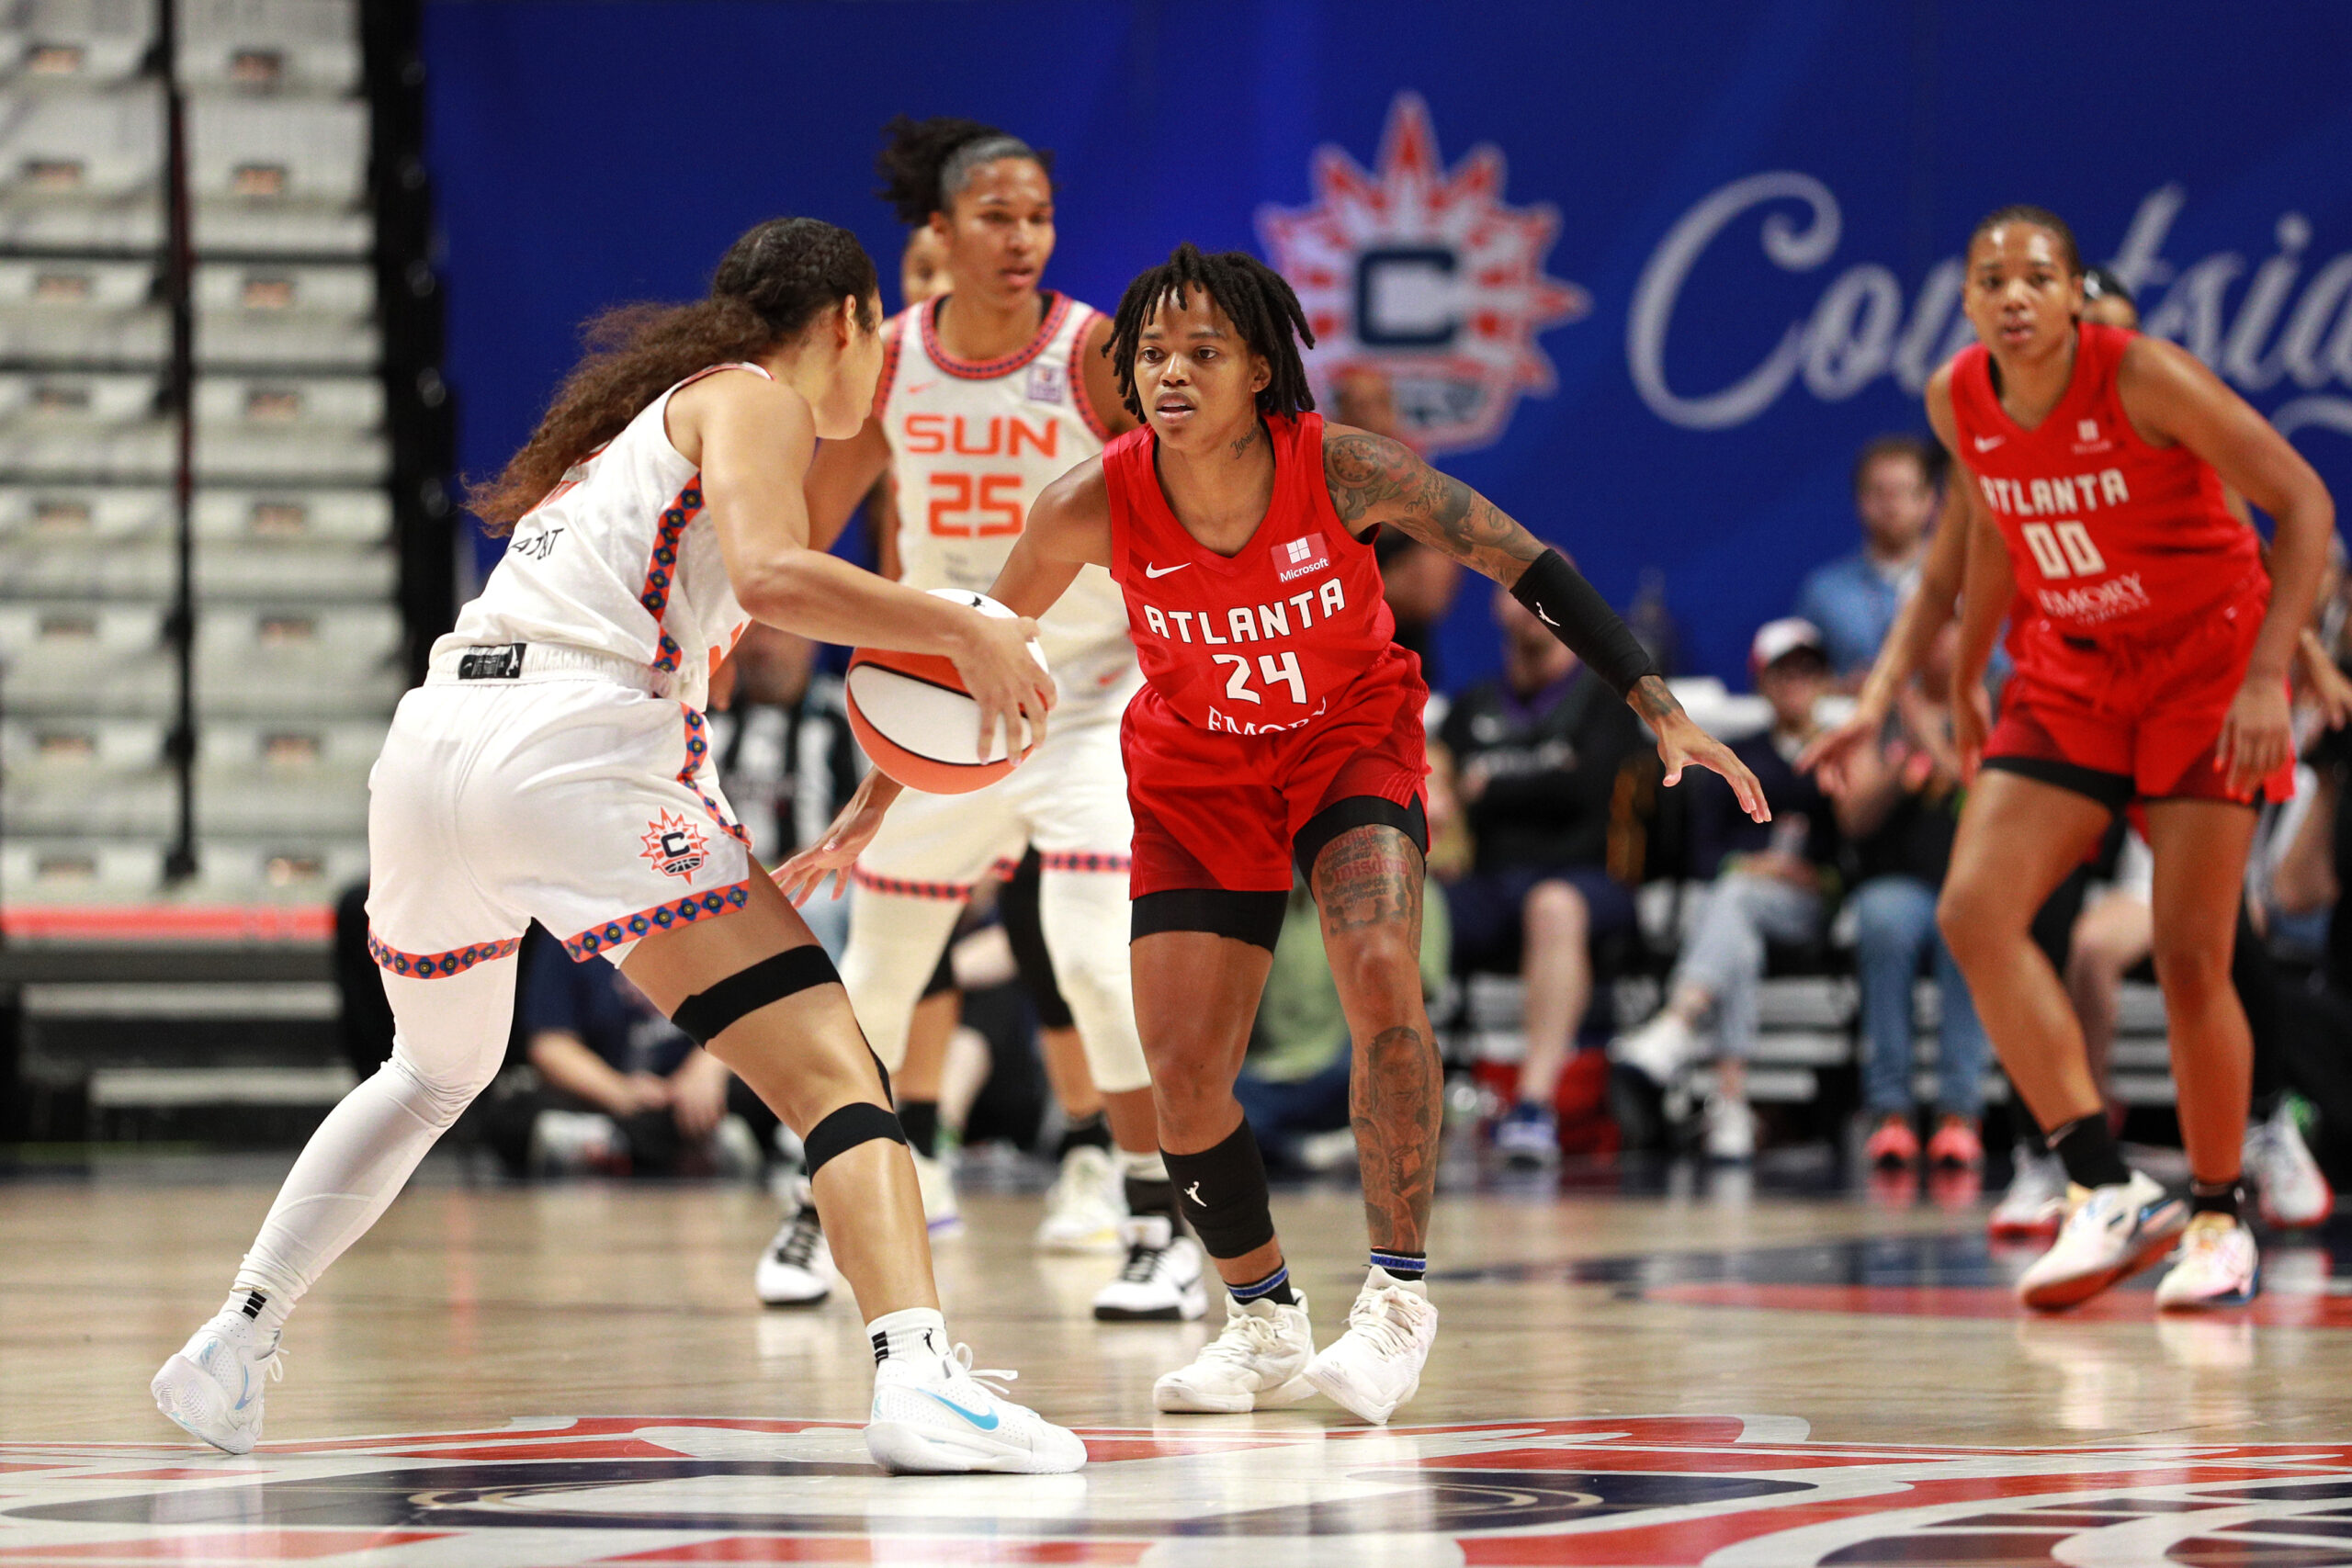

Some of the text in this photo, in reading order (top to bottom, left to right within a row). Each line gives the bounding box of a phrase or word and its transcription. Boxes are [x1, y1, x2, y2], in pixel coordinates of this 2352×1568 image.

[905, 415, 1059, 458] SUN
[929, 473, 1024, 538] 25
[1978, 468, 2130, 516] ATLANTA
[1280, 558, 1329, 583] Microsoft
[2021, 520, 2108, 580] 00
[1143, 577, 1346, 645] ATLANTA
[1211, 651, 1308, 705] 24
